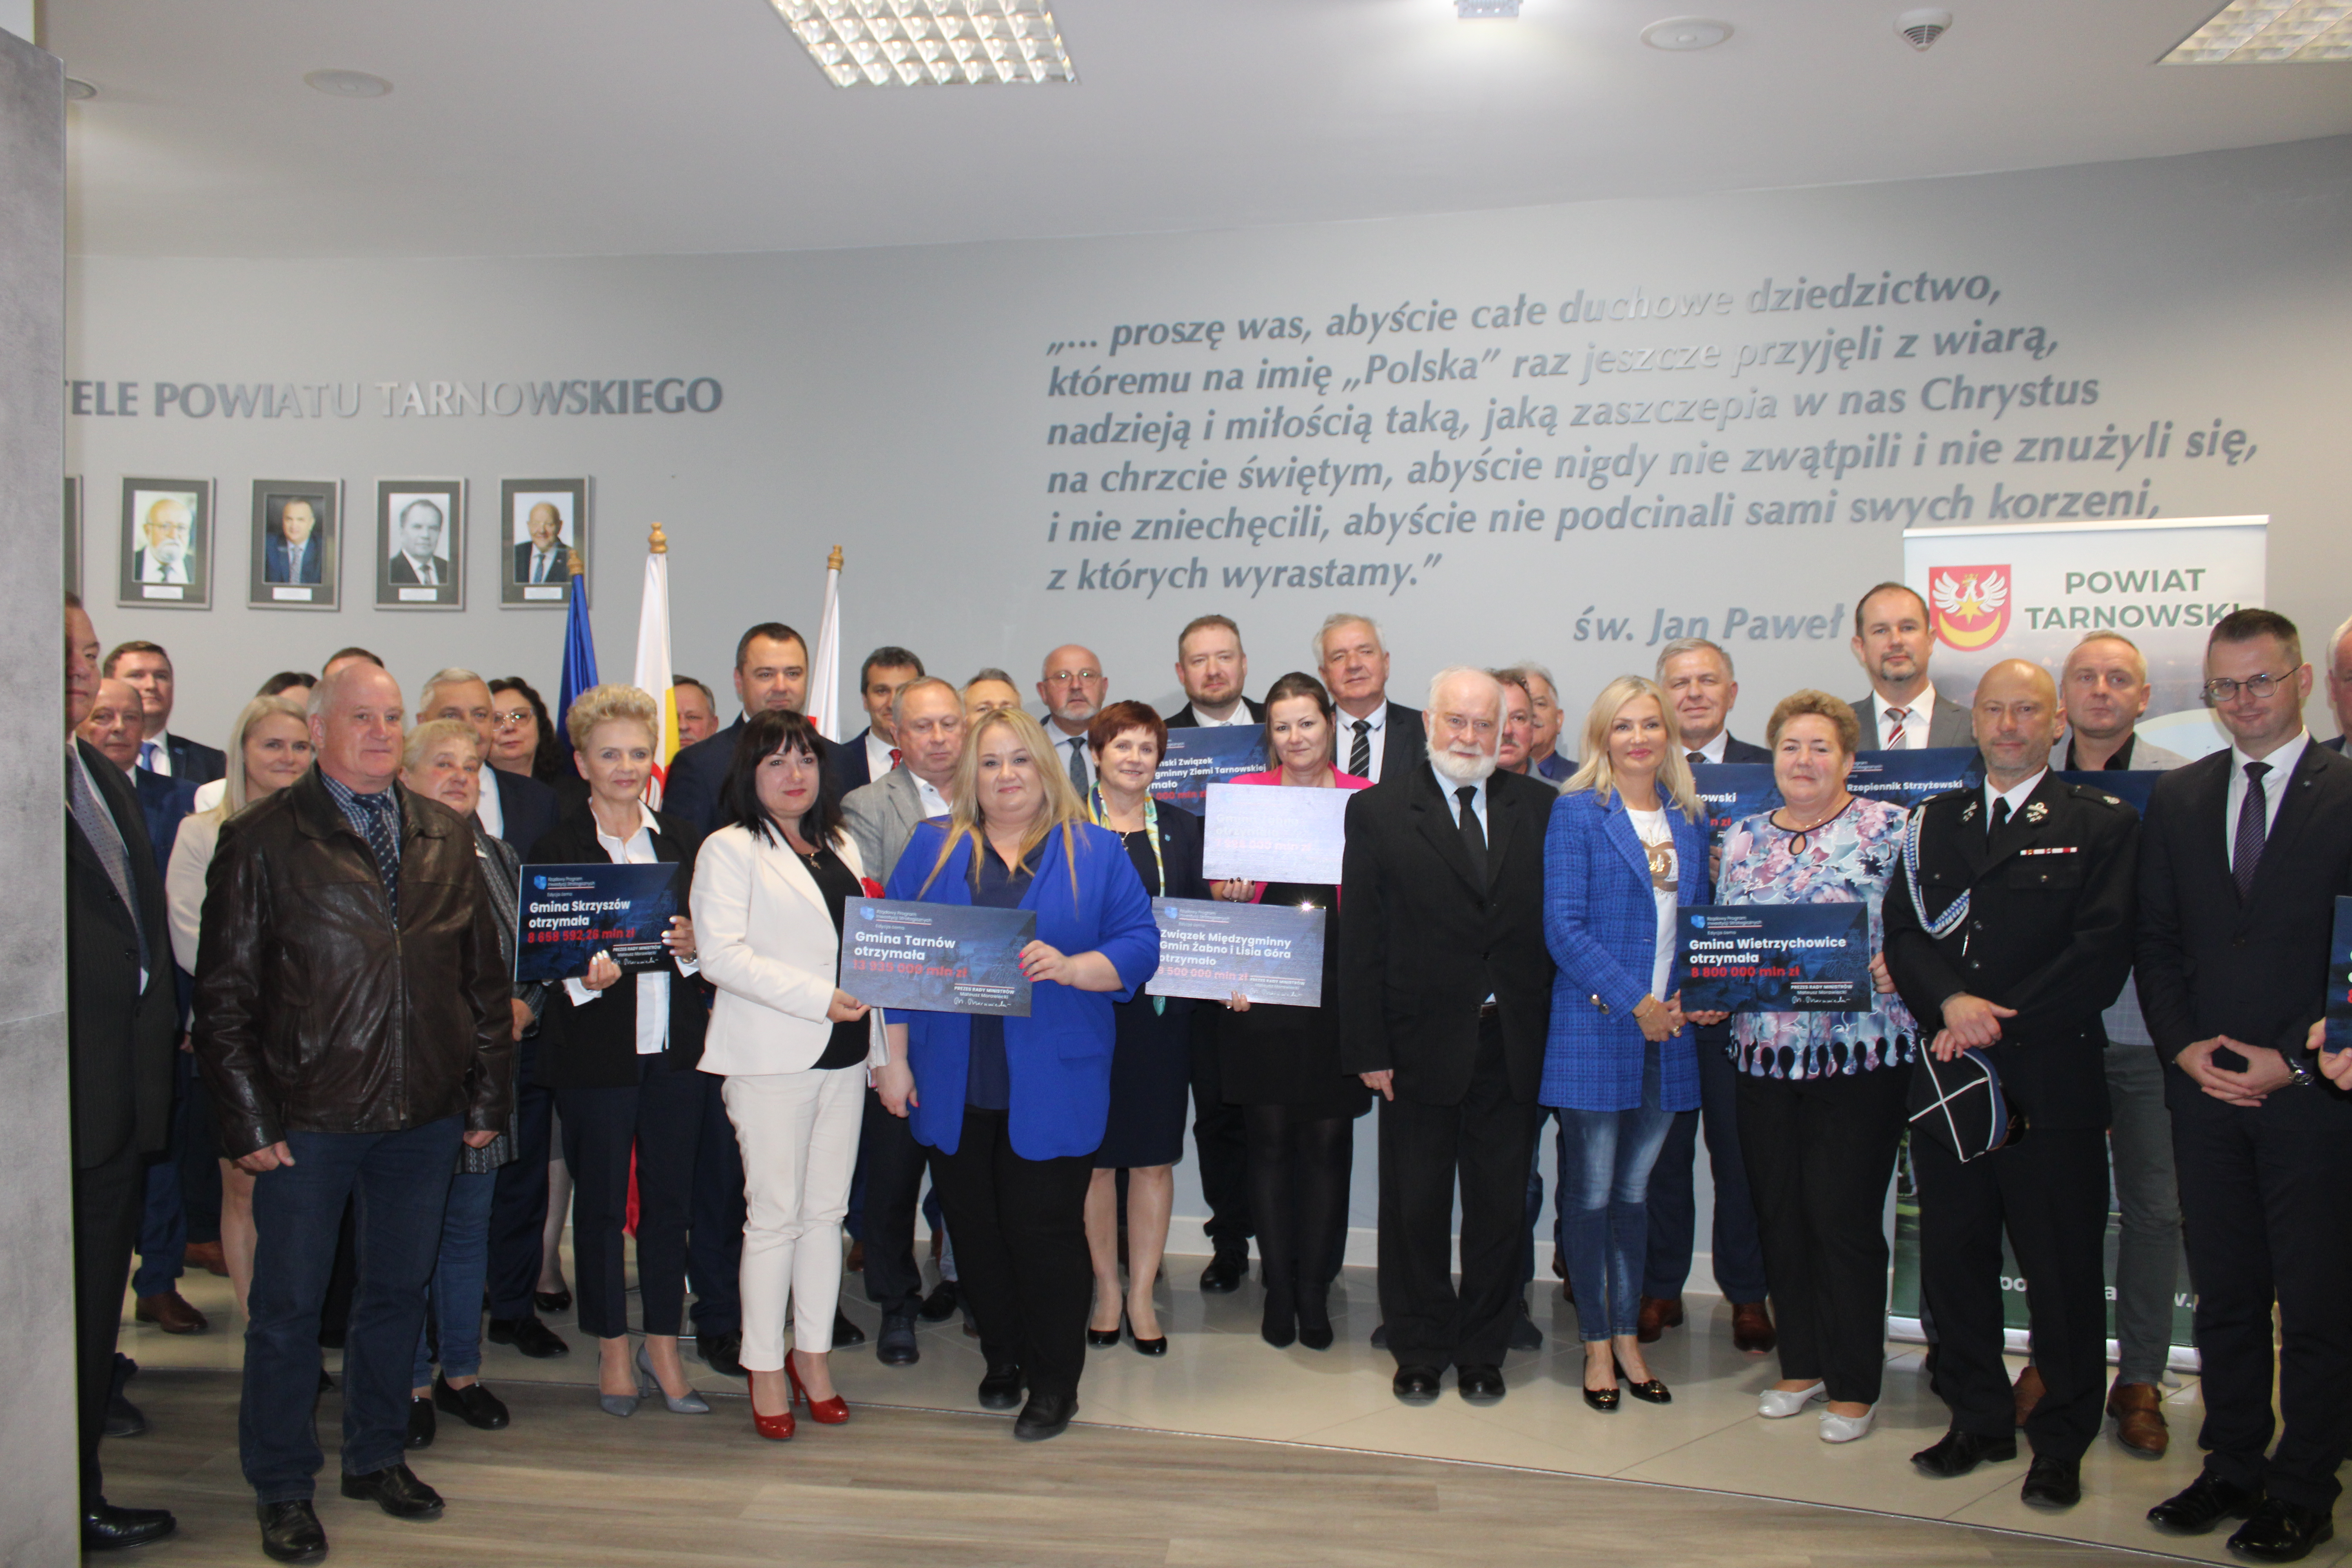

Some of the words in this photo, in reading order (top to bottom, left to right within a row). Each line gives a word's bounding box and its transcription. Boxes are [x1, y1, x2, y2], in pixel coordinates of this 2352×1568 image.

[1110, 317, 1225, 355] proszę
[1238, 309, 1312, 345] was,
[1326, 299, 1457, 344] abyście
[1471, 292, 1546, 329] całe
[1559, 285, 1733, 325] duchowe
[1747, 270, 2000, 314] dziedzictwo,
[1047, 364, 1191, 397] któremu
[1203, 368, 1243, 392] na
[1256, 356, 1332, 394] imię
[1512, 348, 1570, 378] raz
[1580, 340, 1720, 385] jeszcze
[1731, 326, 1883, 376] przyjęli
[1894, 335, 1917, 358] z
[1933, 319, 2059, 360] wiarą,
[65, 379, 138, 417] ELE
[154, 381, 361, 417] POWIATU
[375, 376, 722, 417] TARNOWSKIEGO
[1047, 412, 1191, 452] nadzieją
[1203, 410, 1215, 440] i
[1226, 403, 1372, 441] miłością
[1386, 399, 1470, 439] taką,
[1481, 395, 1558, 441] jaką
[1570, 387, 1777, 430] zaszczepia
[1793, 391, 1828, 416] w
[1838, 387, 1906, 415] nas
[1921, 373, 2099, 421] Chrystus
[1047, 467, 1088, 494] na
[1100, 458, 1227, 491] chrzcie
[1238, 455, 1393, 496] świętym,
[1407, 447, 1542, 492] abyście
[1555, 443, 1658, 490] nigdy
[1669, 441, 1730, 475] nie
[1741, 432, 1901, 480] zwątpili
[1913, 432, 1926, 467] i
[1938, 430, 2001, 466] nie
[2014, 420, 2172, 473] znużyli
[2185, 419, 2258, 466] się,
[1046, 512, 1060, 543] i
[1069, 510, 1120, 541] nie
[1131, 505, 1330, 548] zniechęcili,
[1343, 501, 1476, 546] abyście
[1489, 499, 1544, 532] nie
[1555, 492, 1735, 541] podcinali
[1745, 489, 1838, 525] sami
[1850, 483, 1974, 528] swych
[1988, 479, 2160, 521] korzeni,
[1047, 567, 1067, 591] z
[1077, 557, 1207, 599] których
[2064, 568, 2207, 594] POWIAT
[1573, 606, 1635, 641] św.
[1646, 607, 1710, 646] Jan
[1723, 603, 1845, 640] Paweł
[1178, 757, 1214, 766] Związek
[1190, 767, 1214, 775] Ziemi
[1214, 763, 1266, 774] Tarnowskiej
[1846, 782, 1902, 793] Rzepiennik
[1902, 779, 1963, 792] Strzyżewski
[1695, 792, 1737, 803] owski
[530, 901, 569, 913] Gmina
[571, 898, 631, 914] Skrzyszów
[528, 915, 590, 931] otrzymała
[528, 932, 535, 943] 8
[537, 931, 560, 943] 658
[602, 928, 623, 939] mln
[625, 927, 636, 938] zł
[855, 931, 901, 946] Gmina
[905, 935, 956, 949] Tarnów
[1160, 929, 1206, 942] Związek
[1208, 933, 1292, 949] Międzygminny
[1160, 940, 1190, 951] Gmin
[1192, 942, 1228, 954] Żabno
[1230, 945, 1234, 955] i
[1236, 946, 1262, 956] Lisia
[1263, 947, 1291, 959] Góra
[1689, 938, 1734, 950] Gmina
[1737, 936, 1847, 952] Wietrzychowice
[854, 946, 926, 961] otrzymała
[1160, 953, 1217, 966] otrzymało
[1689, 952, 1759, 967] otrzymała
[853, 959, 866, 971] 13
[869, 960, 894, 973] 935
[897, 962, 923, 975] 000
[926, 965, 954, 977] mln
[955, 967, 967, 978] zł
[1190, 968, 1212, 979] 000
[1214, 971, 1236, 980] mln
[1238, 972, 1248, 981] zł
[1691, 967, 1699, 978] 8
[1702, 966, 1728, 977] 800
[1730, 966, 1756, 977] 000
[1759, 965, 1786, 976] mln
[1788, 965, 1800, 976] zł
